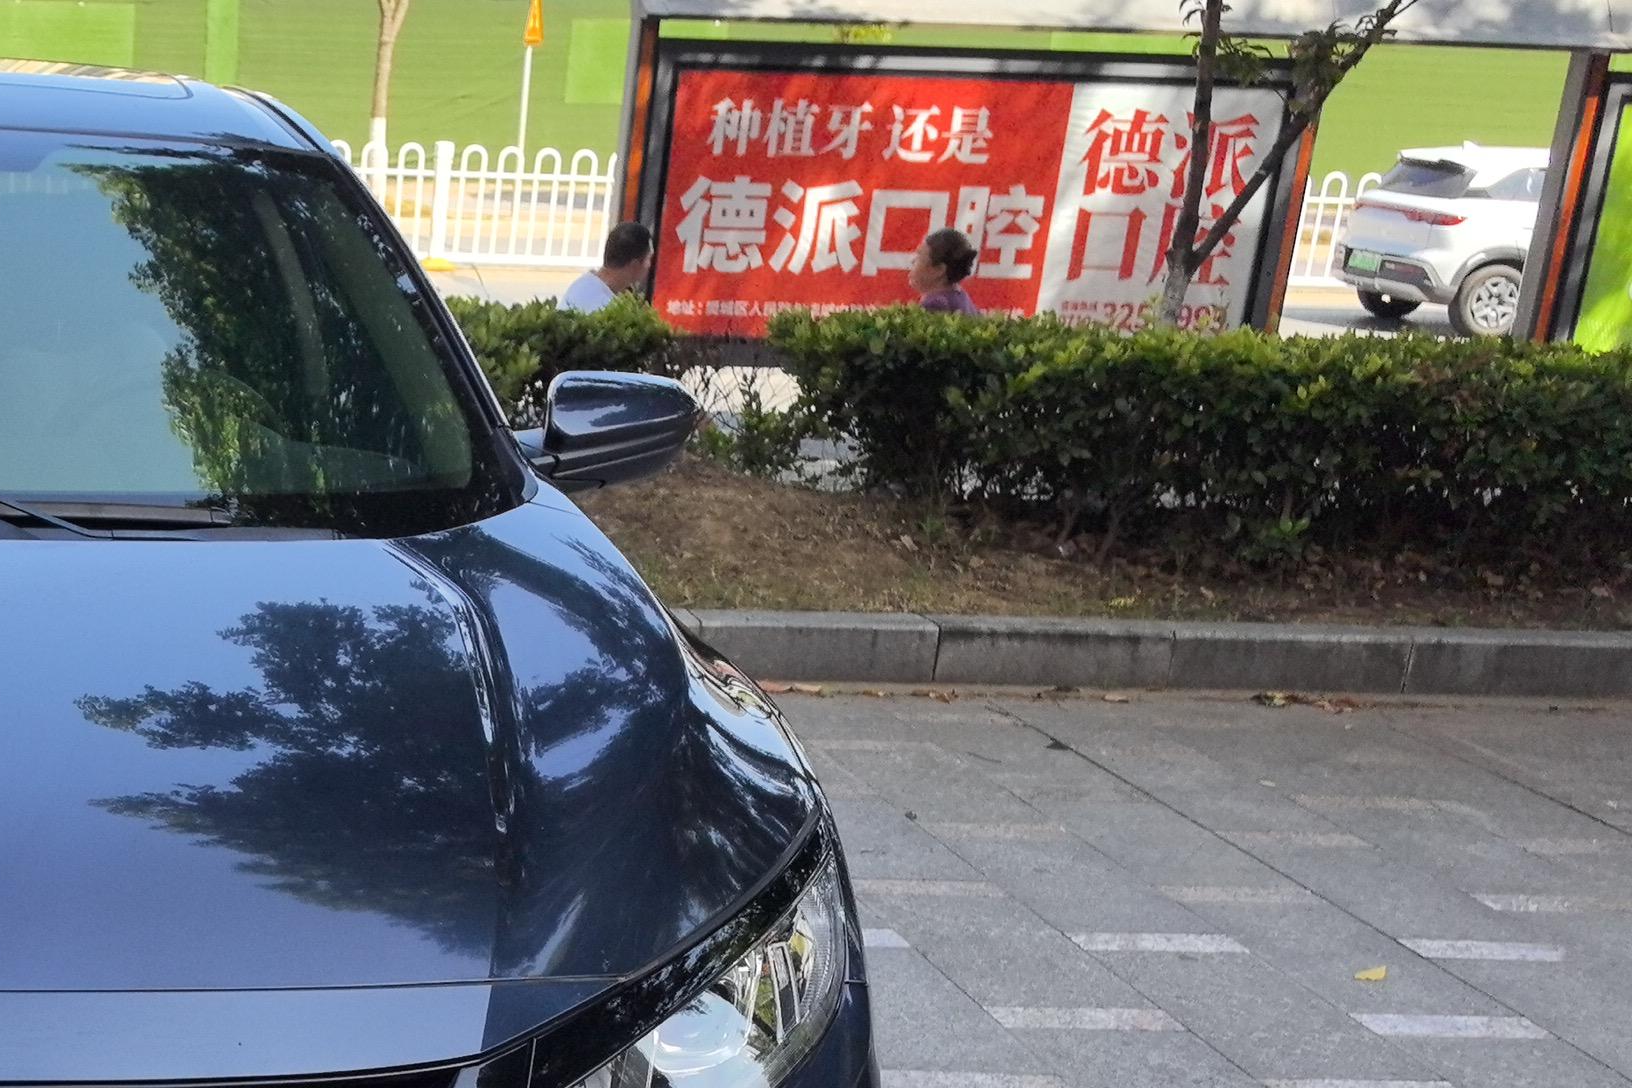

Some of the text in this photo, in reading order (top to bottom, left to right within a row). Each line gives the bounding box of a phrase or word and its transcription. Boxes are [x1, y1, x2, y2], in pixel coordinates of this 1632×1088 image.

[707, 98, 994, 165] 种植牙 还是
[1080, 108, 1261, 199] 德派
[675, 174, 1046, 280] 德派口腔
